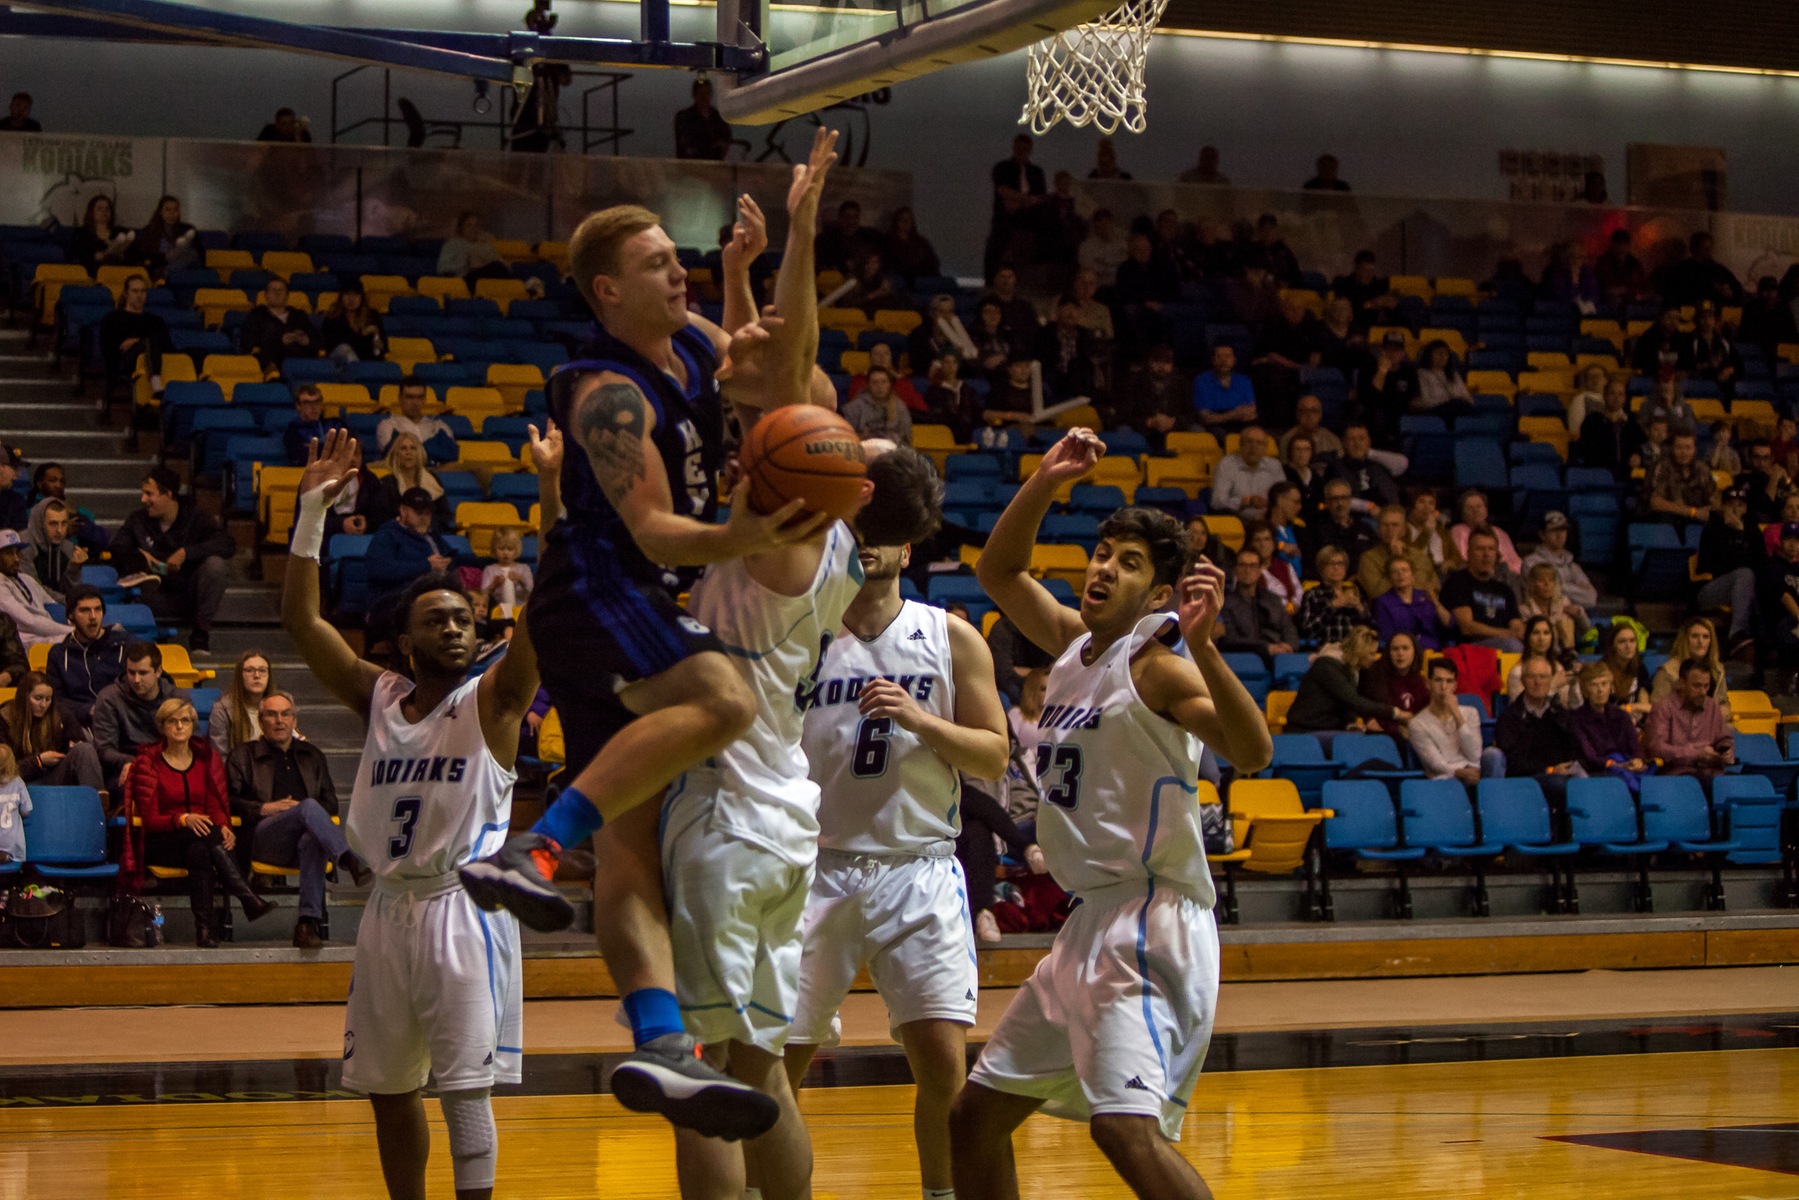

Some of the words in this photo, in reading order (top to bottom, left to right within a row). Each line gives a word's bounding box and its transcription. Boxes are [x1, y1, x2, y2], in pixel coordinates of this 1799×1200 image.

[809, 674, 933, 710] KODKS
[1037, 705, 1104, 730] ODIAKS
[851, 714, 894, 779] 6
[388, 795, 423, 861] 3
